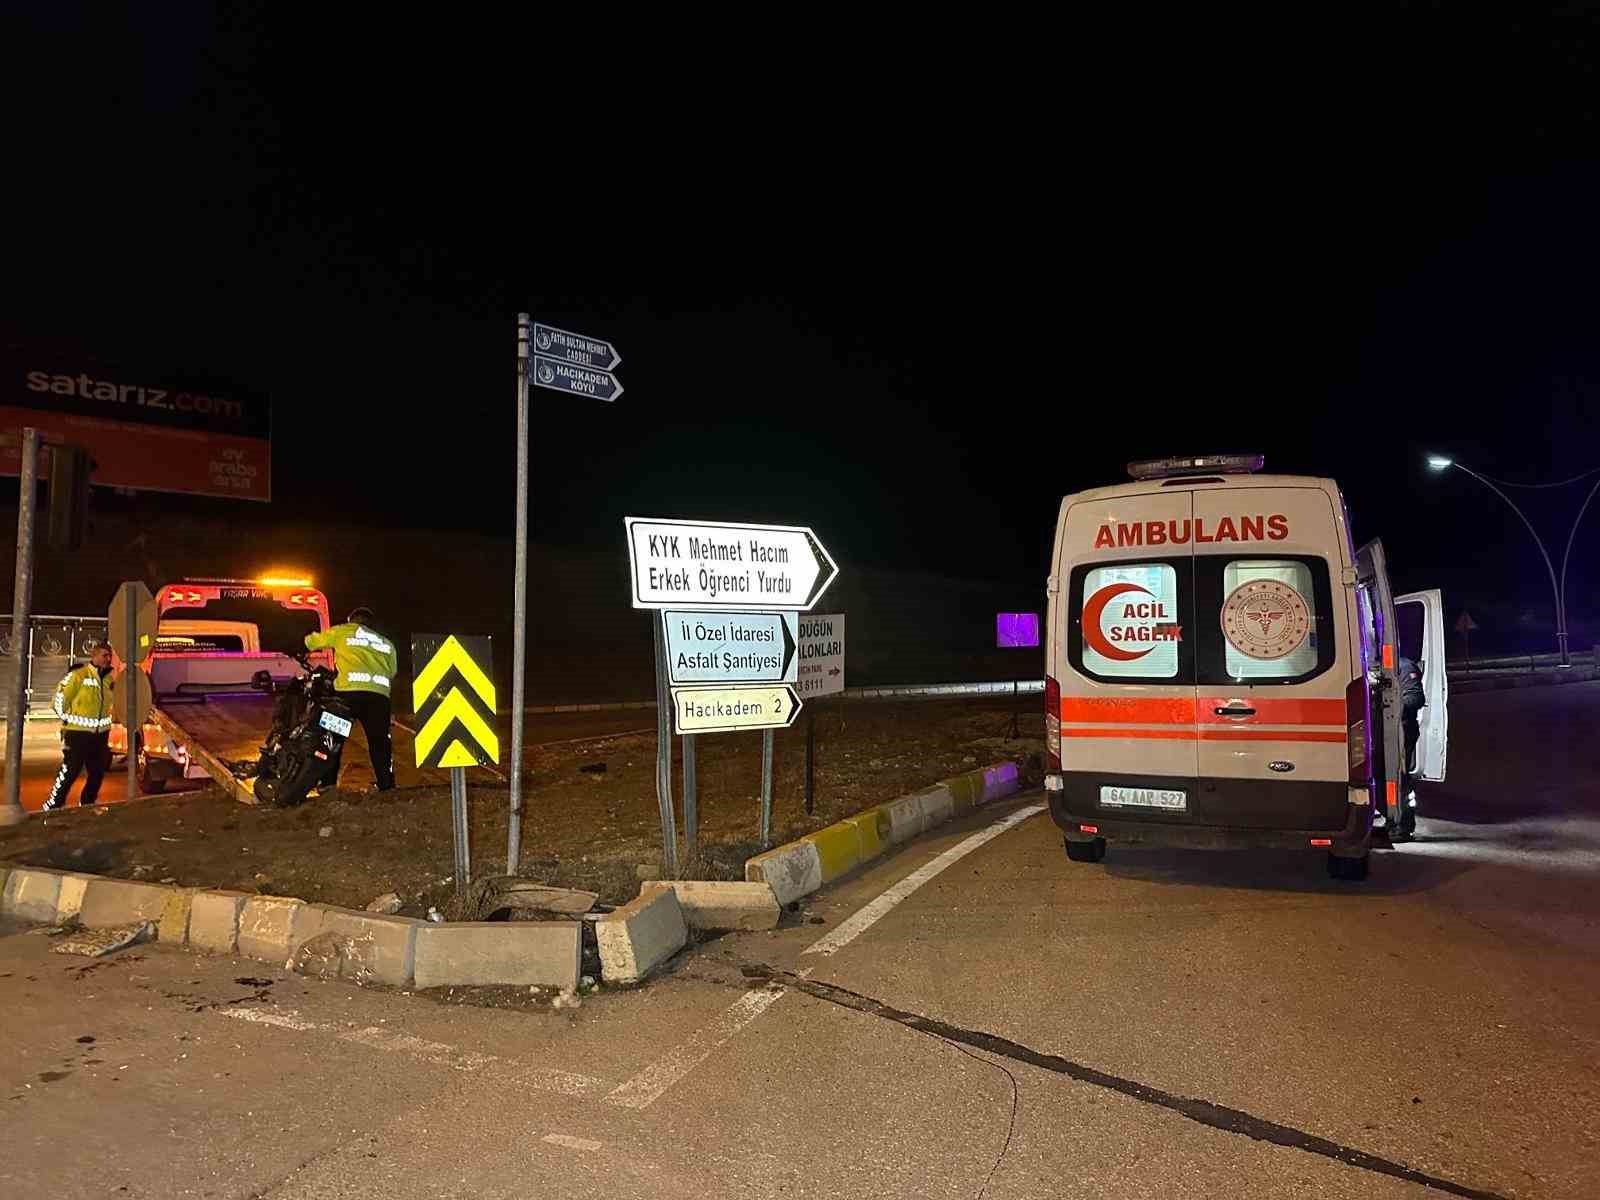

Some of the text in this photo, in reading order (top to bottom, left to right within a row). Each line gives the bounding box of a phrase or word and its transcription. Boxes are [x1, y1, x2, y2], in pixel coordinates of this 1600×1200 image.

[556, 364, 609, 386] HACIKADEM
[1095, 514, 1289, 549] AMBULANS
[648, 534, 789, 563] KYK Mehmet Hacım
[649, 562, 792, 597] Erkek Öğrenci Yurdu
[1123, 600, 1169, 618] ACİL
[681, 620, 775, 642] İl Özel İdaresi
[677, 652, 720, 669] Asfalt
[722, 651, 781, 672] Şantiyesi
[798, 641, 842, 660] LONLARI
[685, 698, 782, 718] Hacıkadem 2
